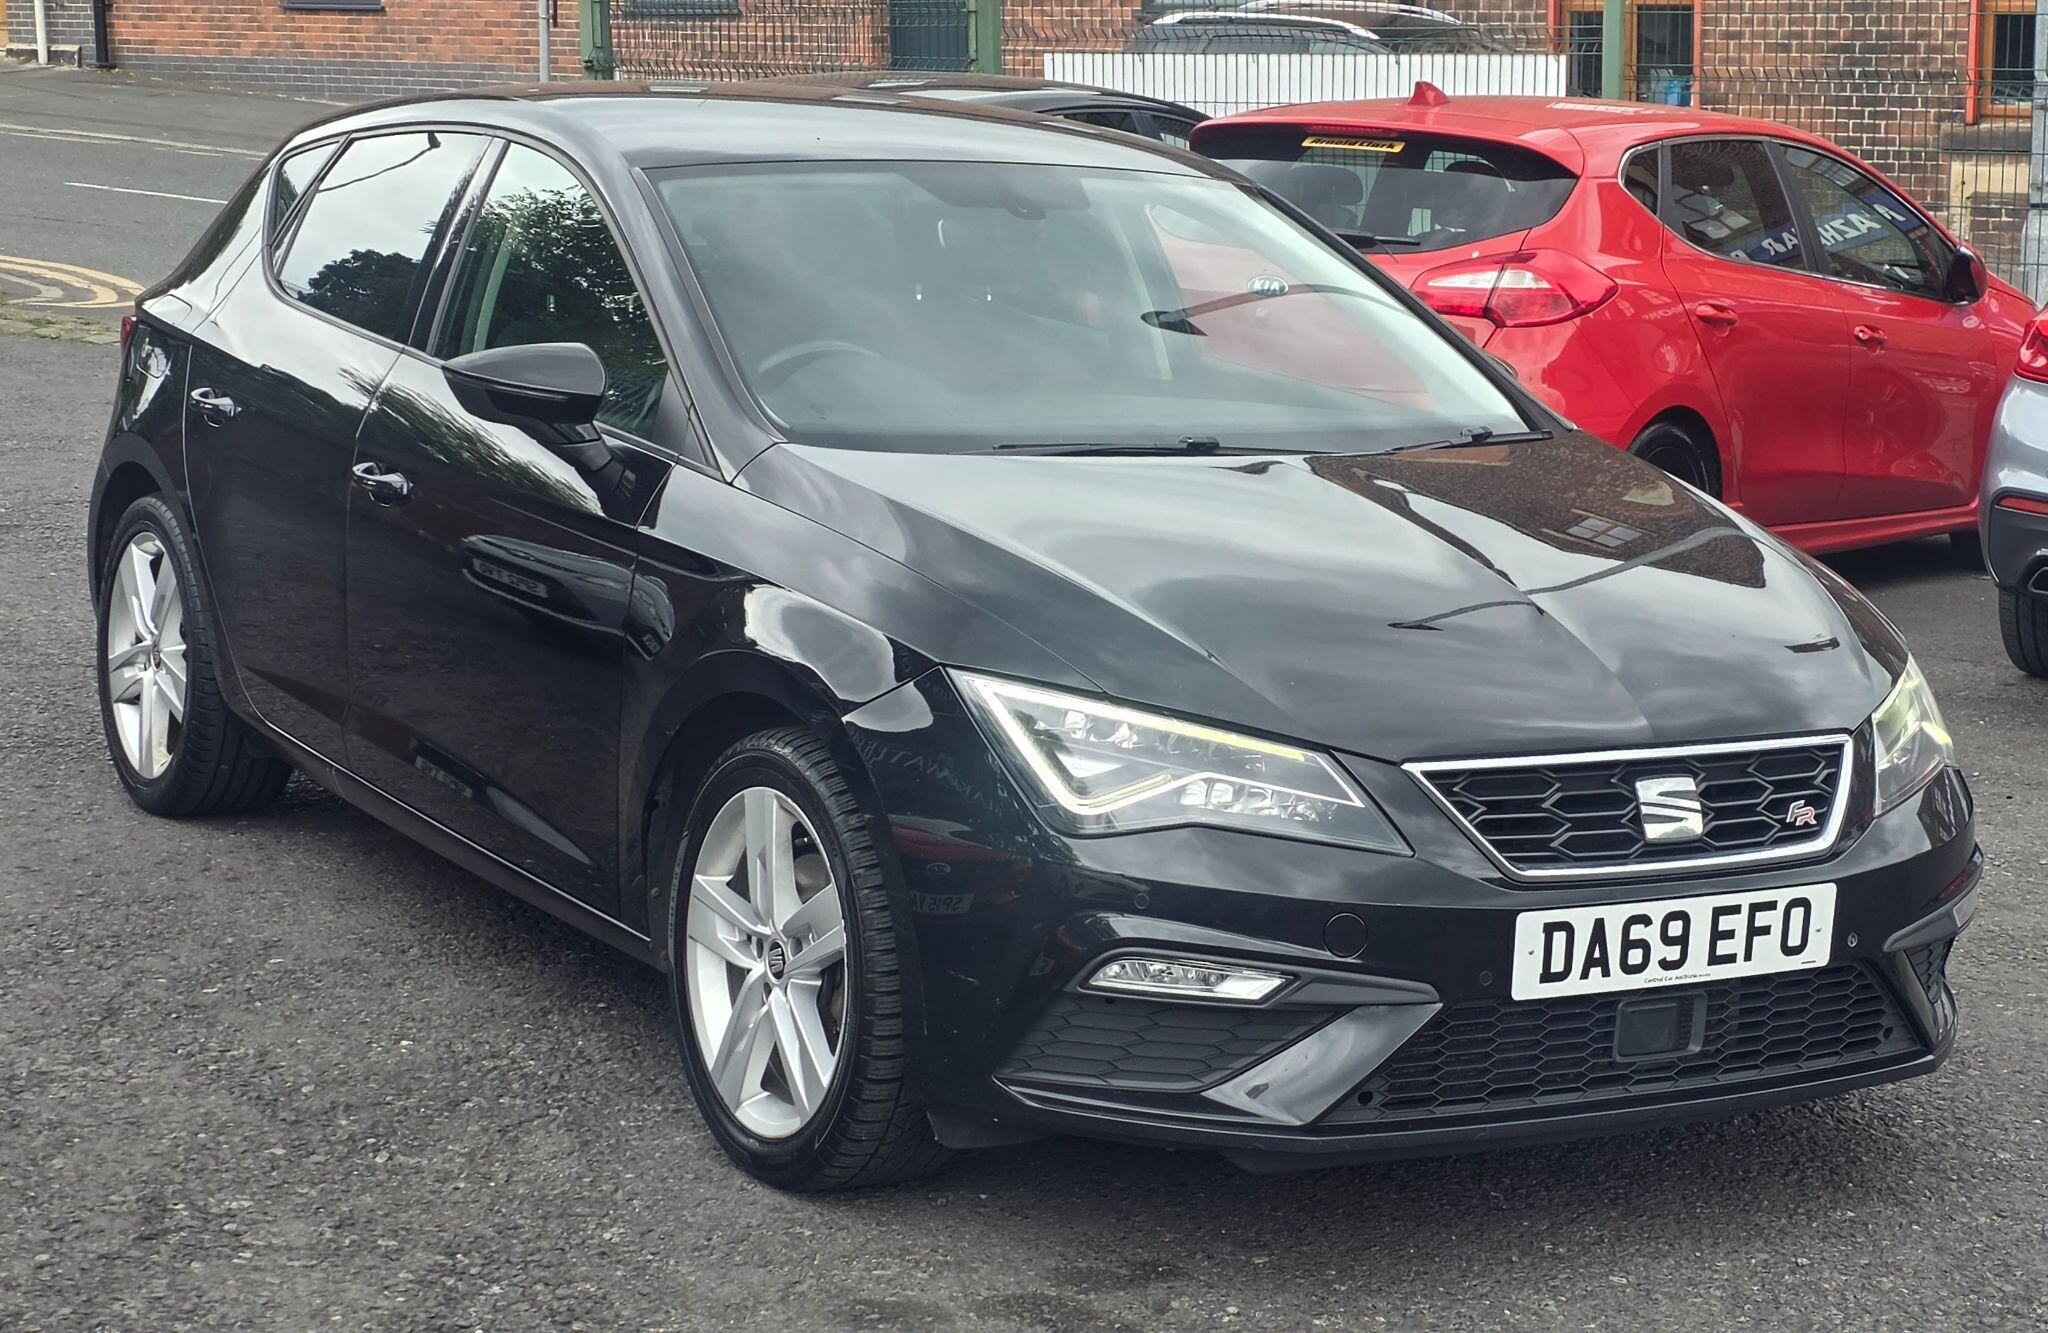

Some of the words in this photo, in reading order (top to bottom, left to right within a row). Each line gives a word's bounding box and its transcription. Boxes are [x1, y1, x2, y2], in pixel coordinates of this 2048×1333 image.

[1310, 138, 1359, 147] Arnold
[1358, 140, 1398, 150] Clark
[1252, 278, 1281, 295] KIA
[1786, 800, 1817, 825] FR
[1539, 910, 1691, 984] DA69
[1707, 897, 1812, 967] EFO
